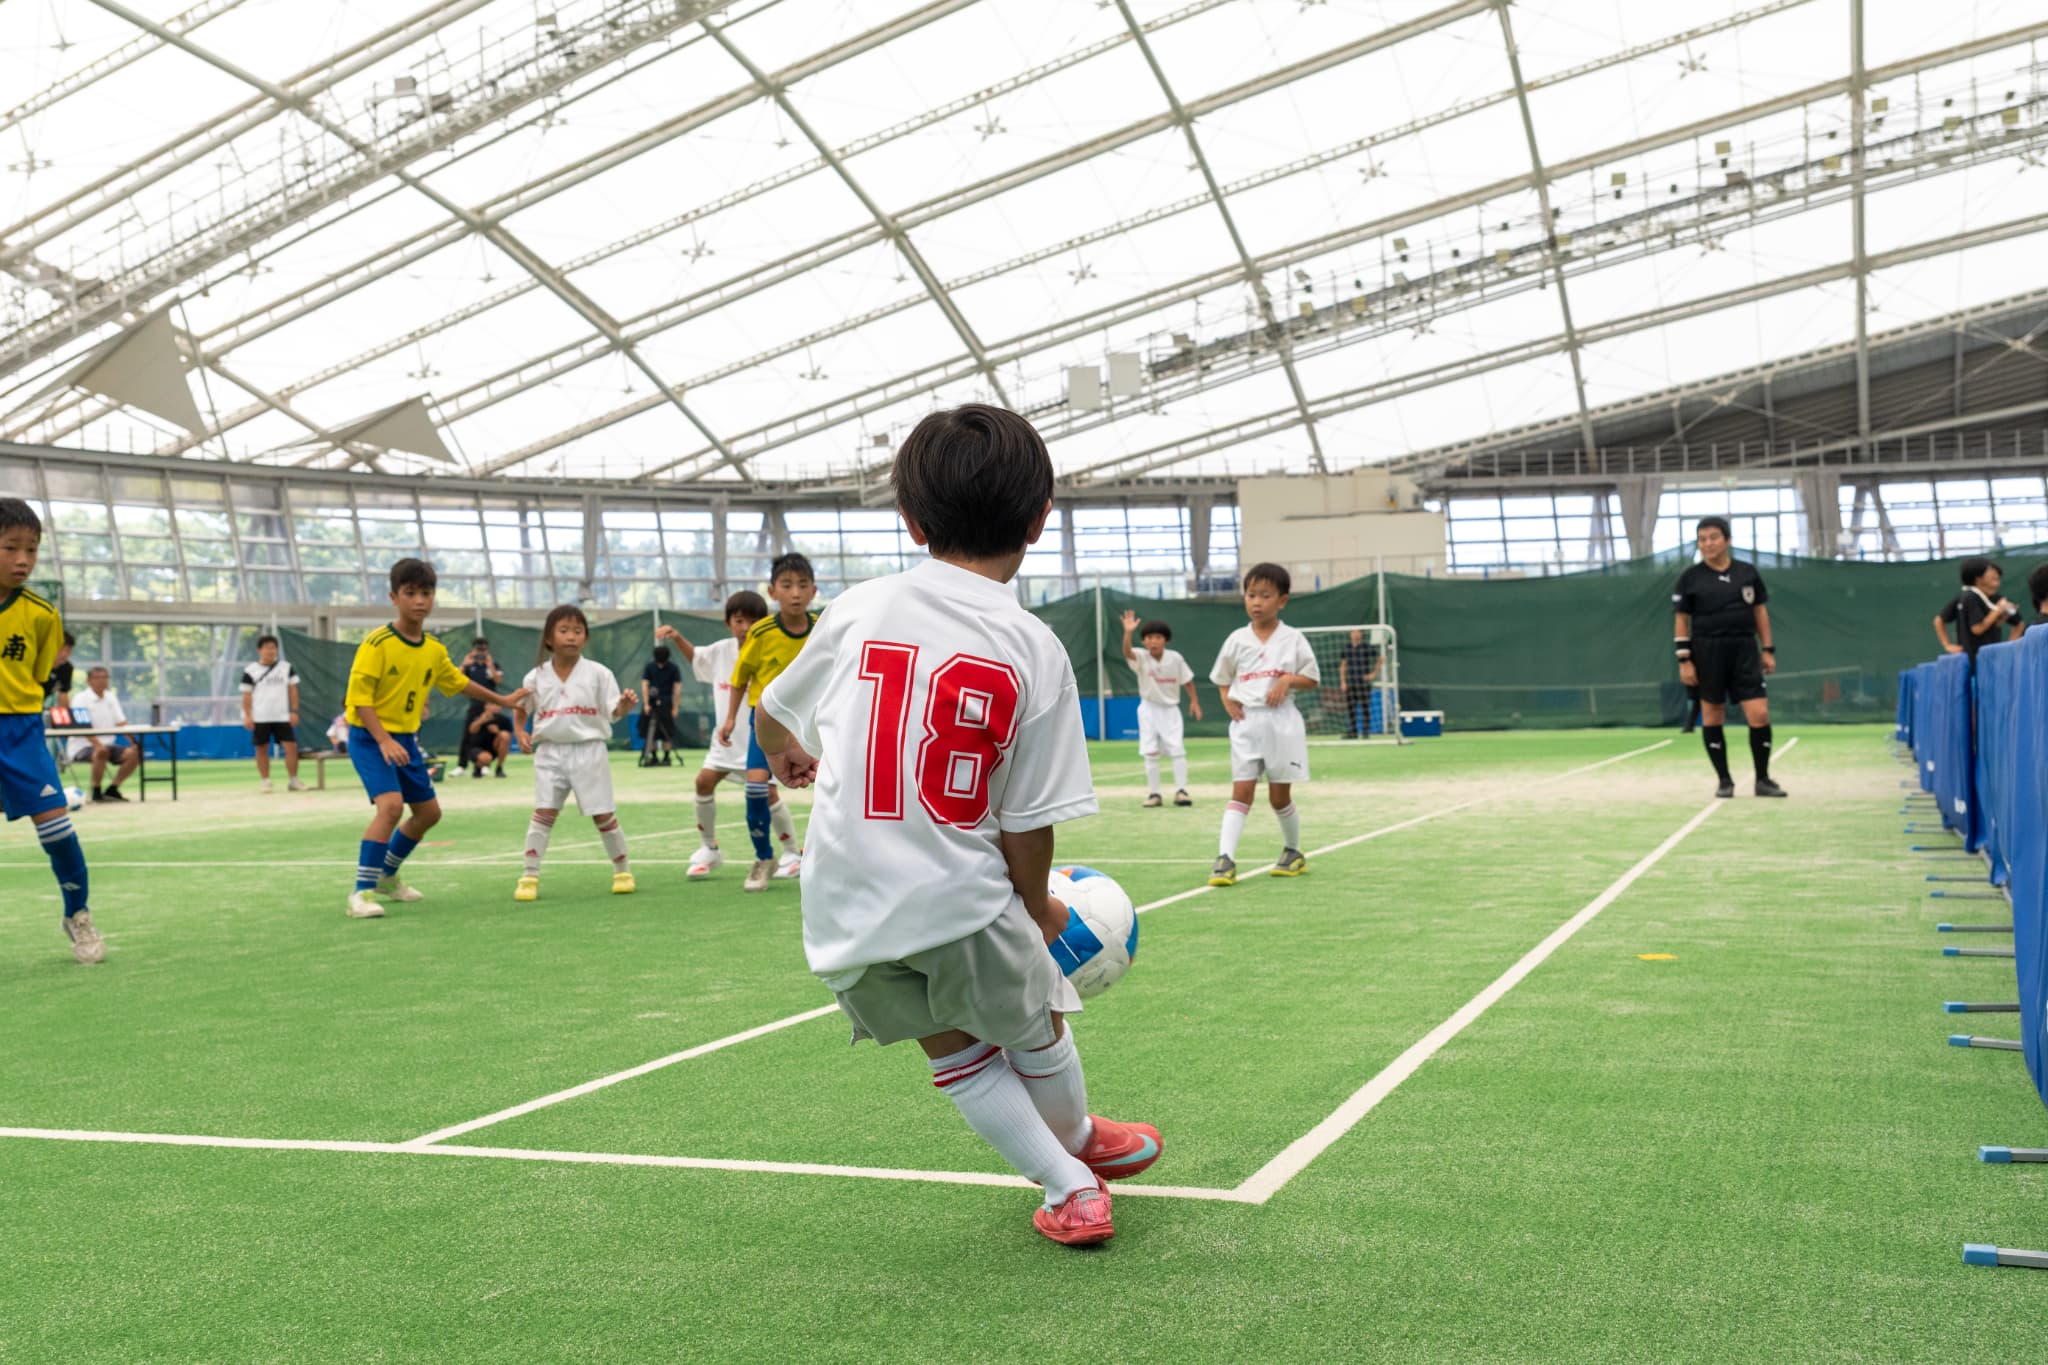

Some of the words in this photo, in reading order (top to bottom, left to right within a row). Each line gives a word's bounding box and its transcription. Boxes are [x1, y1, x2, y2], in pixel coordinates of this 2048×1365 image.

[1, 634, 26, 661] 南
[405, 690, 417, 713] 6
[858, 640, 1021, 830] 18
